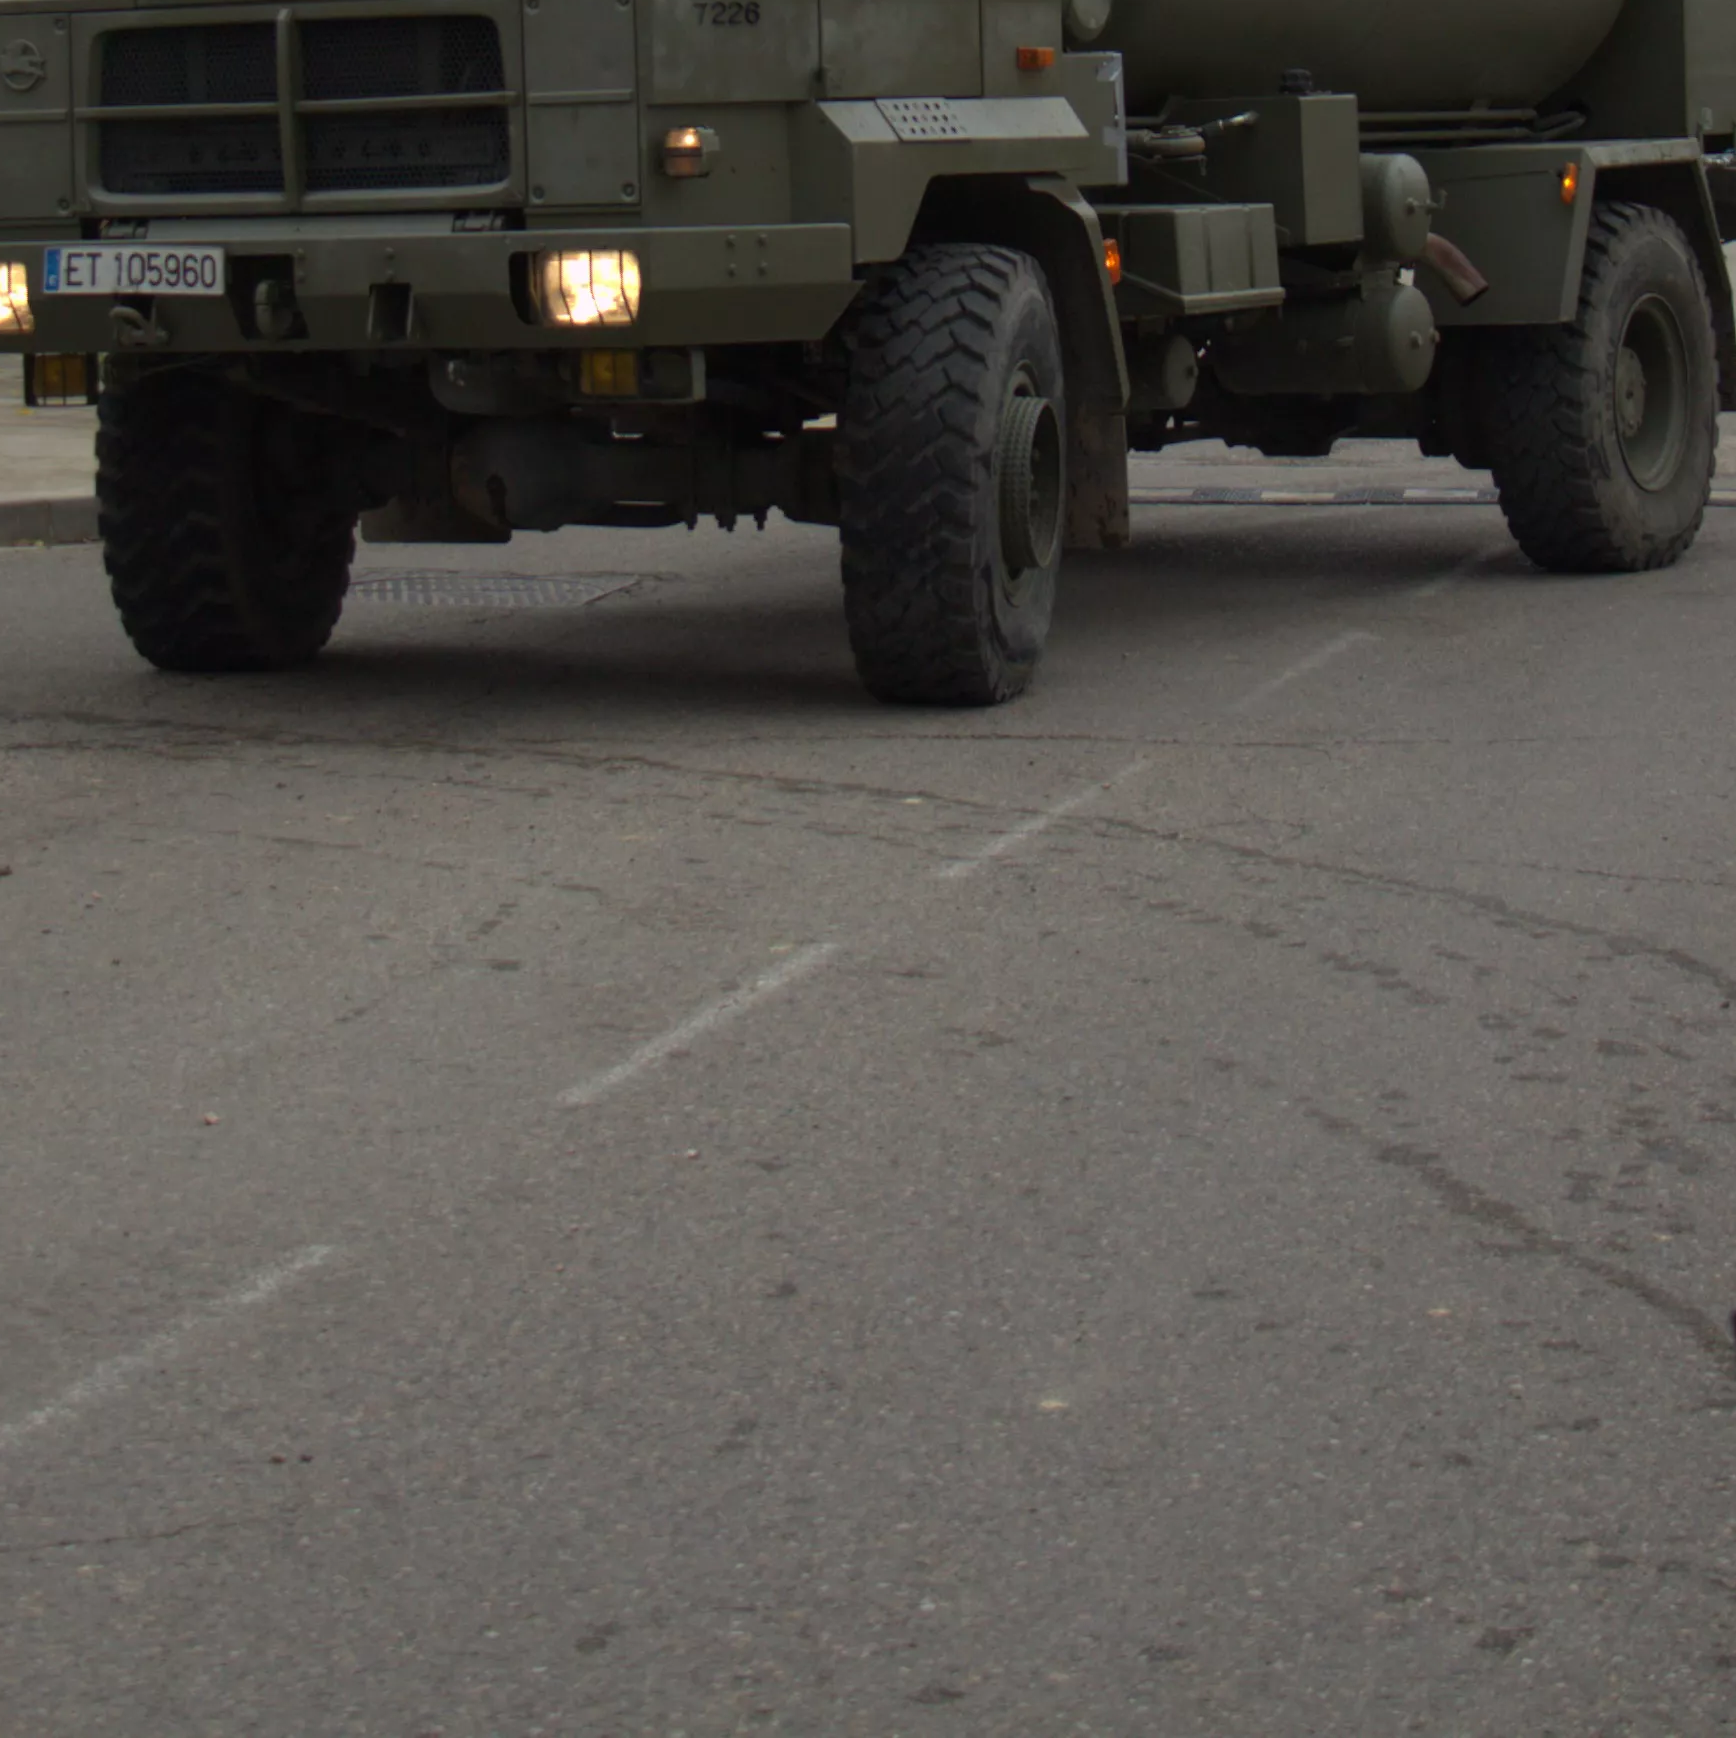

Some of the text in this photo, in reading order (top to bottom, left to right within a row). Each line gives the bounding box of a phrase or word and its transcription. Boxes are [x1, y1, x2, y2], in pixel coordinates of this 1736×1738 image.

[693, 0, 761, 26] 7226
[65, 251, 217, 289] ET 105960
